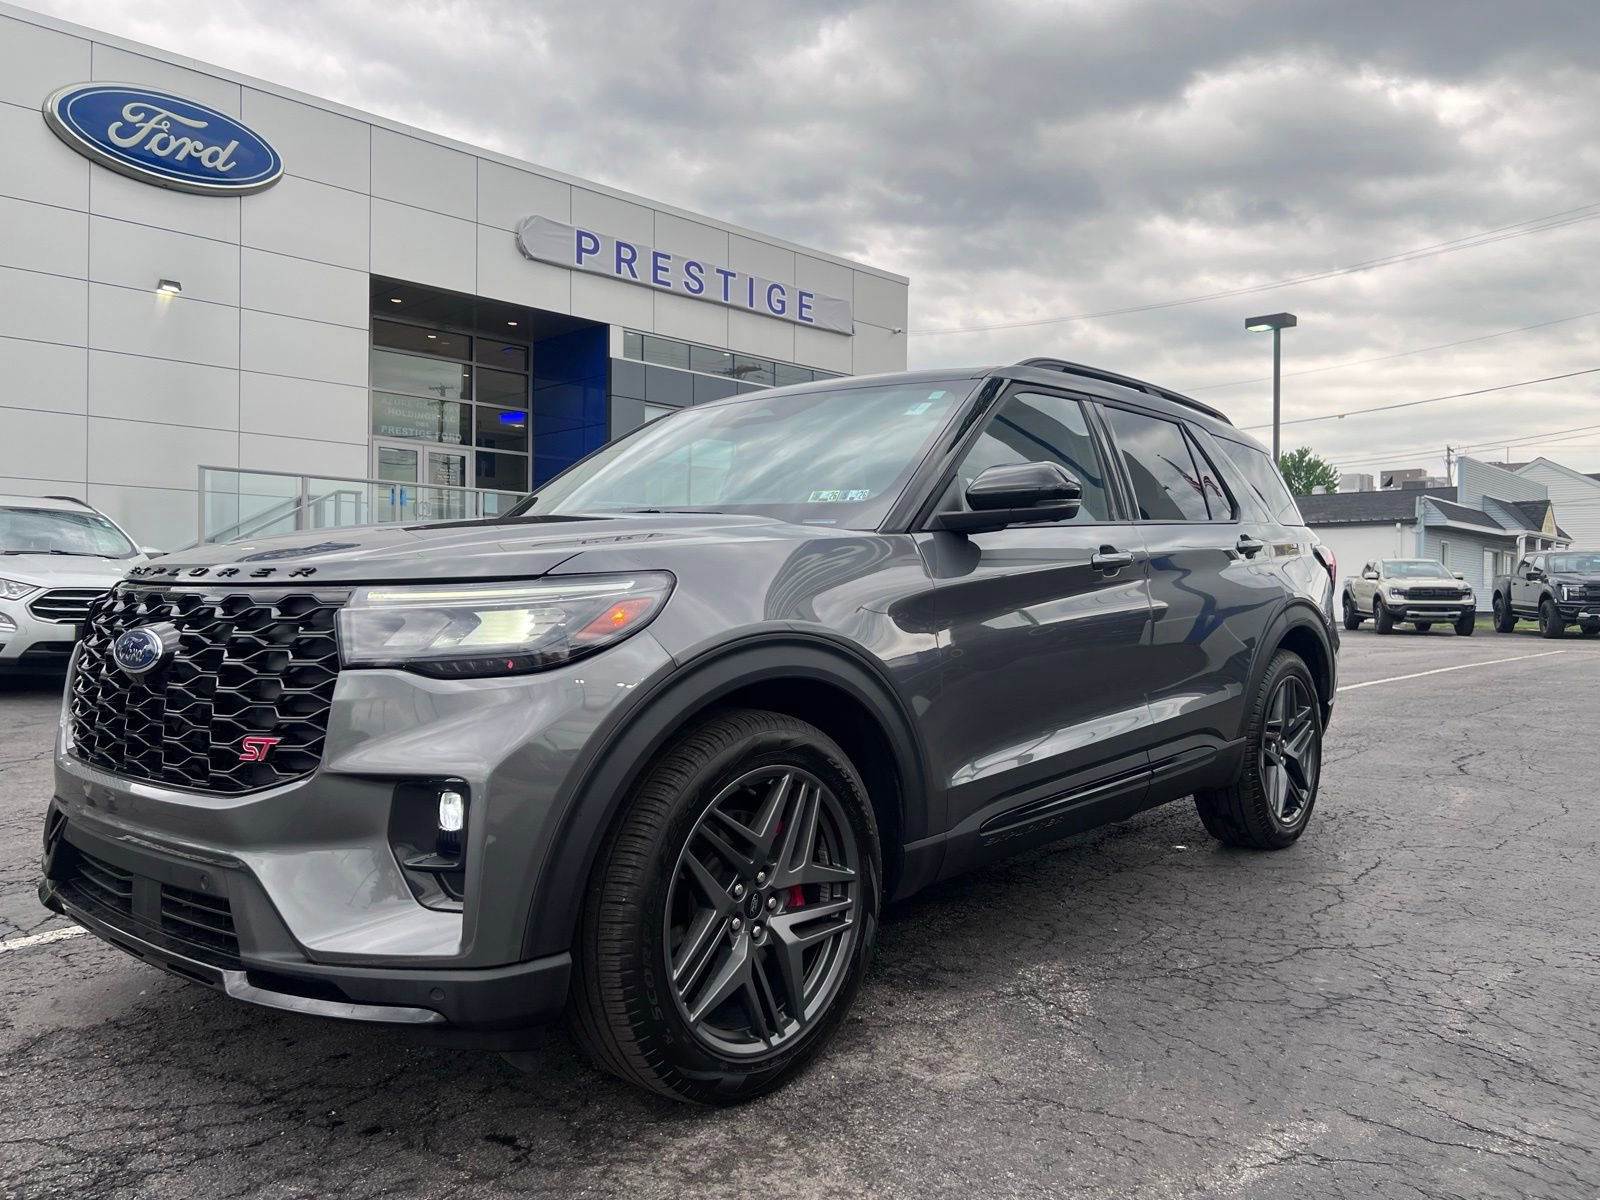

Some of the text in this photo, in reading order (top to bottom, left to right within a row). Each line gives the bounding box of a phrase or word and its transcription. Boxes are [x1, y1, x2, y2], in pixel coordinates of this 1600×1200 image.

[107, 102, 239, 172] Ford
[575, 229, 815, 323] PRESTIGE
[380, 424, 463, 442] PRESTIGE FORD
[117, 636, 149, 662] Ford
[239, 736, 284, 762] ST
